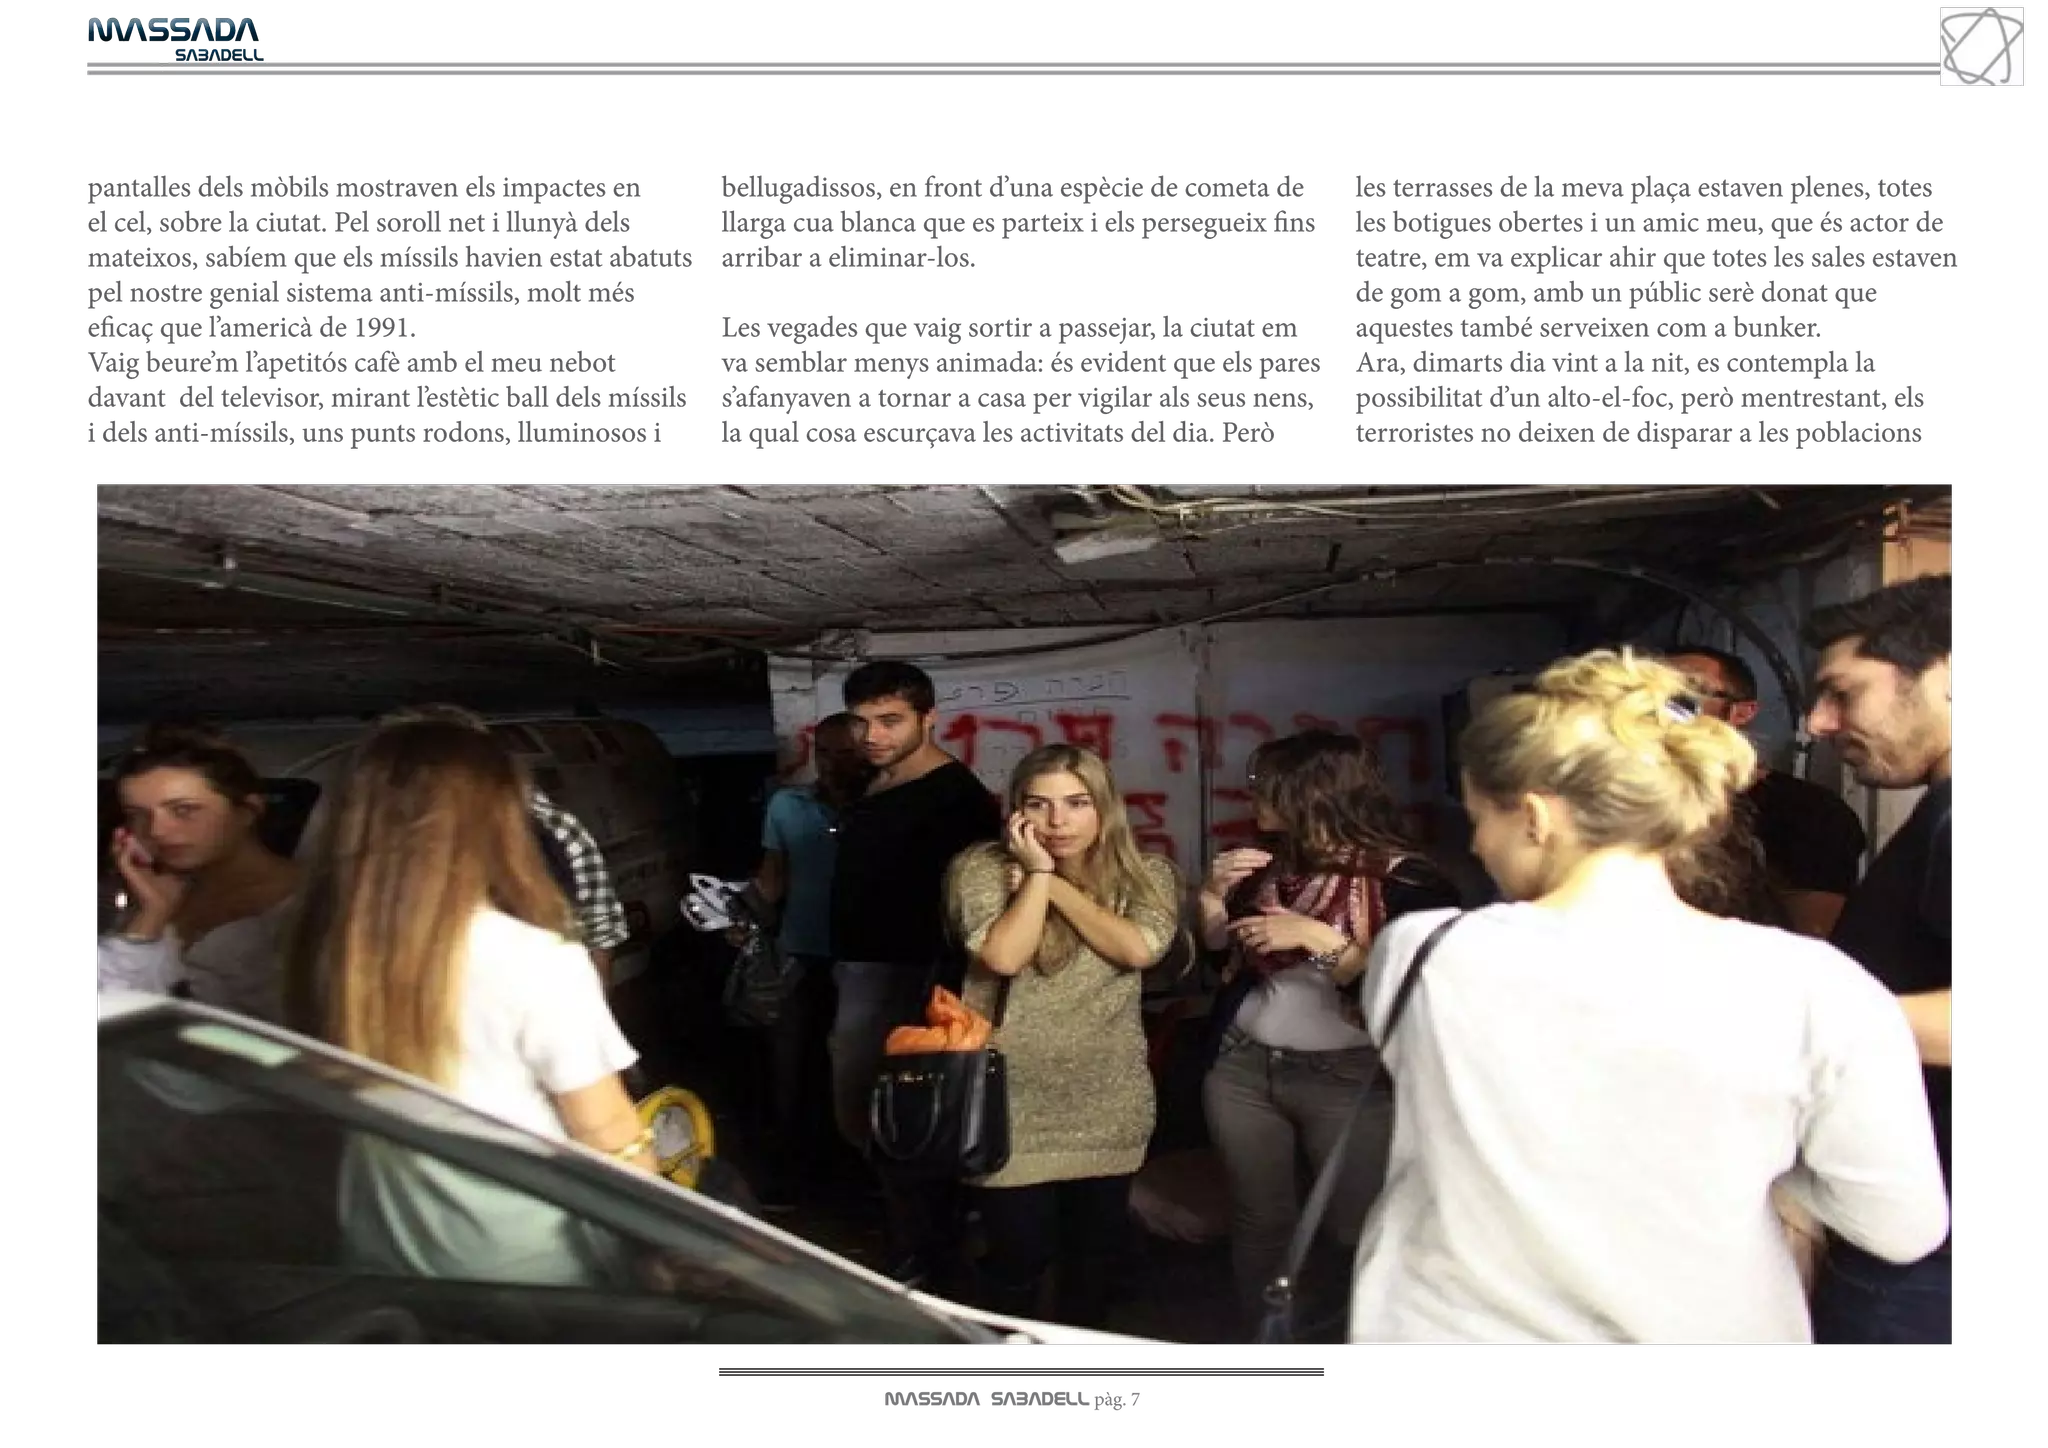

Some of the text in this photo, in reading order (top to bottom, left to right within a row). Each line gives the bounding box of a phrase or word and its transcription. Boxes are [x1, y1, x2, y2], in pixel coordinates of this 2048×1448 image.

[88, 17, 259, 42] MASSADA
[175, 48, 264, 62] SABADELL
[87, 174, 641, 205] pantalles dels mòbils mostraven els impactes en
[721, 174, 883, 205] bellugadissos,
[889, 182, 918, 198] en
[924, 174, 983, 198] front
[1060, 175, 1144, 205] espècie
[1150, 174, 1179, 198] de
[1184, 178, 1270, 198] cometa
[1276, 174, 1305, 198] de
[1355, 174, 1933, 205] les terrasses de la meva plaça estaven plenes, totes
[1355, 209, 1944, 240] les botigues obertes i un amic meu, que és actor de
[87, 244, 693, 275] mateixos, sabíem que els míssils havien estat abatuts
[721, 245, 976, 268] arribar a eliminar-los.
[1355, 244, 1958, 275] teatre, em va explicar ahir que totes les sales estaven
[87, 280, 635, 310] pel nostre genial sistema anti-míssils, molt més
[87, 314, 154, 344] eficaç
[160, 322, 203, 345] que
[319, 315, 348, 338] de
[356, 317, 416, 338] 1991.
[722, 315, 1298, 345] Les vegades que vaig sortir a passejar, la ciutat em
[1356, 315, 1821, 345] aquestes també serveixen com a bunker.
[87, 351, 140, 380] Vaig
[354, 349, 401, 373] cafè
[407, 350, 458, 373] amb
[464, 350, 485, 373] el
[490, 357, 543, 373] meu
[549, 350, 617, 373] nebot
[721, 350, 1321, 380] va semblar menys animada: és evident que els pares
[87, 385, 167, 408] davant
[179, 385, 215, 408] del
[220, 385, 324, 411] televisor,
[331, 387, 411, 408] mirant
[505, 385, 549, 408] ball
[555, 385, 602, 408] dels
[607, 385, 687, 408] míssils
[1355, 385, 1483, 415] possibilitat
[1547, 384, 1674, 411] alto-el-foc,
[1680, 386, 1734, 415] però
[1740, 389, 1887, 411] mentrestant,
[1894, 385, 1925, 408] els
[87, 420, 662, 450] i dels anti-míssils, uns punts rodons, lluminosos i
[721, 420, 1275, 450] la qual cosa escurçava les activitats del dia. Però
[1355, 420, 1922, 450] terroristes no deixen de disparar a les poblacions
[884, 1391, 1141, 1411] MASSADA SABADELL pàg. 7
